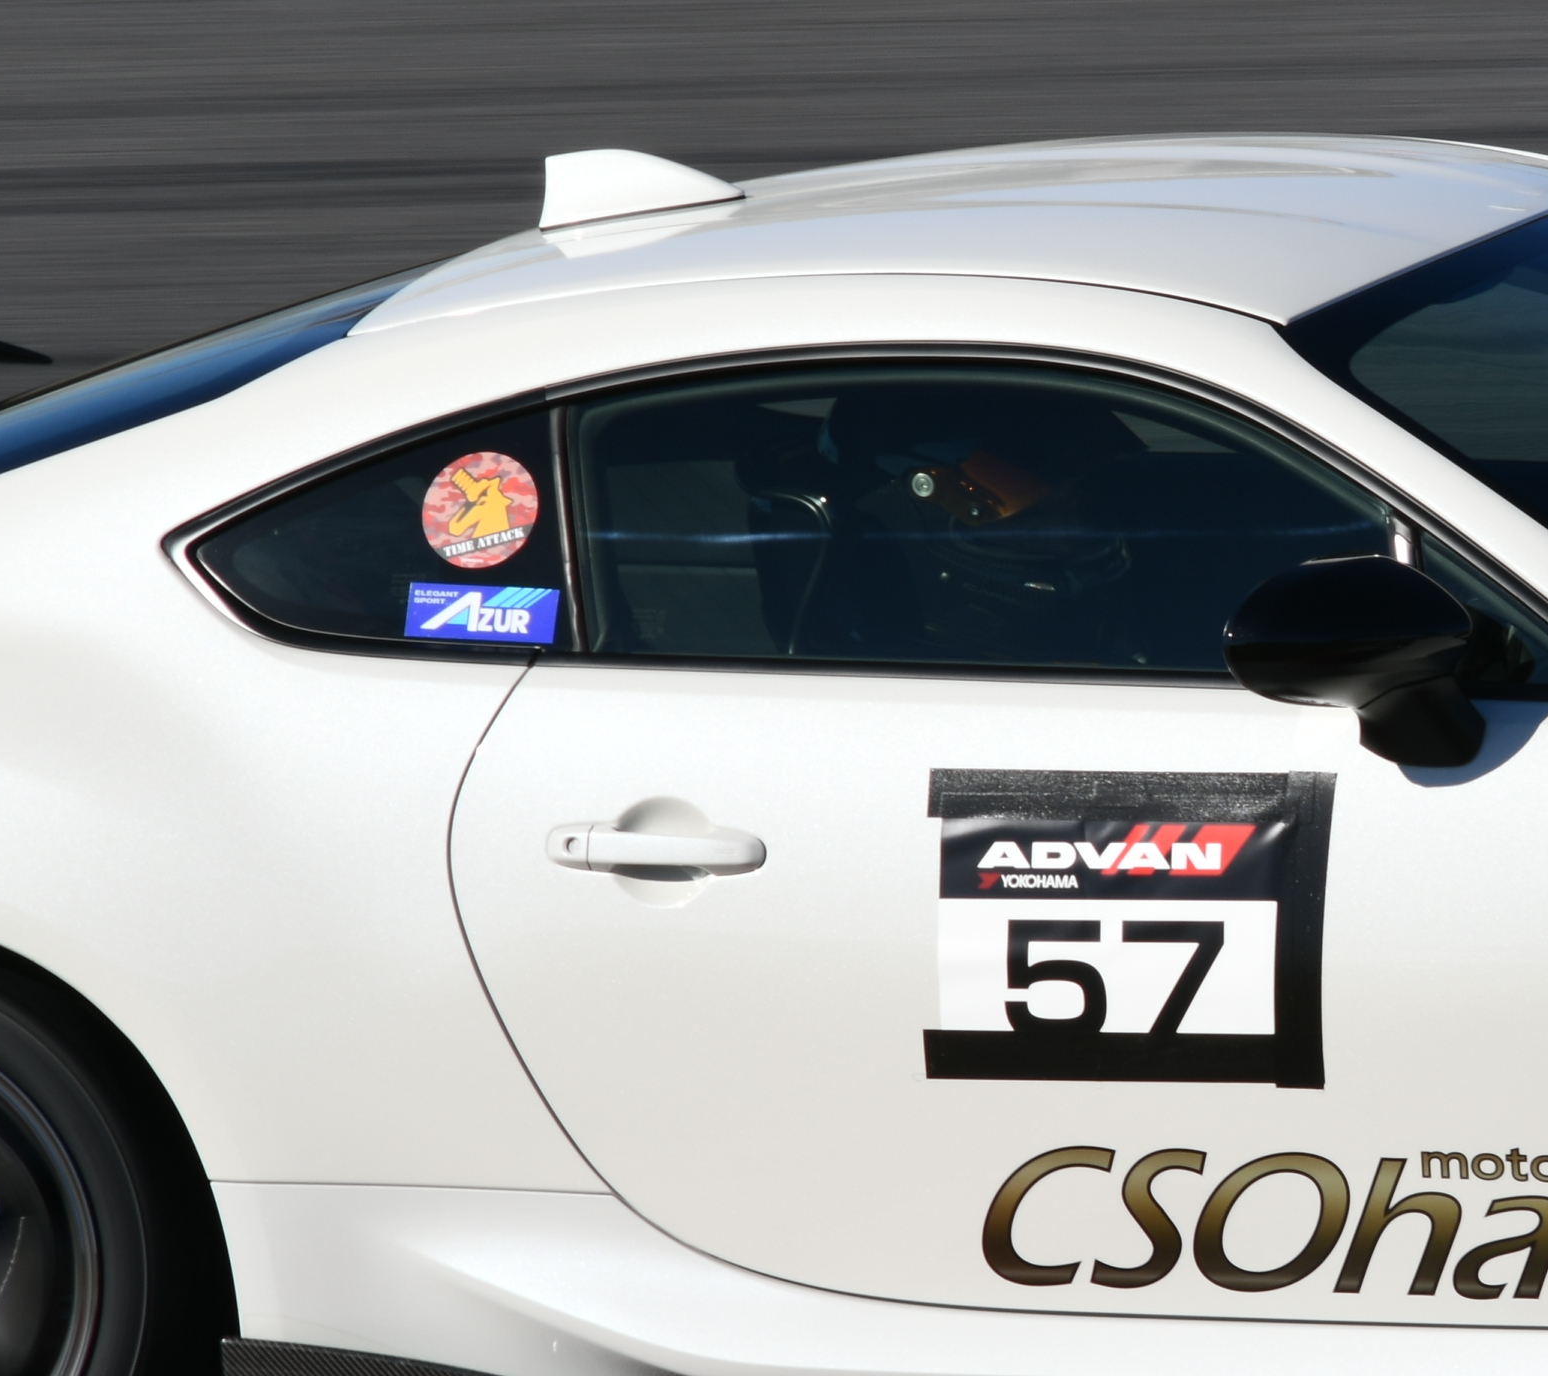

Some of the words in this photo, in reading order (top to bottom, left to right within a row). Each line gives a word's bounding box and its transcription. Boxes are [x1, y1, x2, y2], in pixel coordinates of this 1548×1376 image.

[443, 540, 475, 557] TIME
[477, 527, 525, 549] ATTACK
[414, 590, 459, 598] ELEGANT
[420, 591, 530, 634] AZUR
[977, 841, 1222, 870] ADVAN
[1001, 874, 1079, 889] YOKOHAMA
[1004, 920, 1224, 1033] 57
